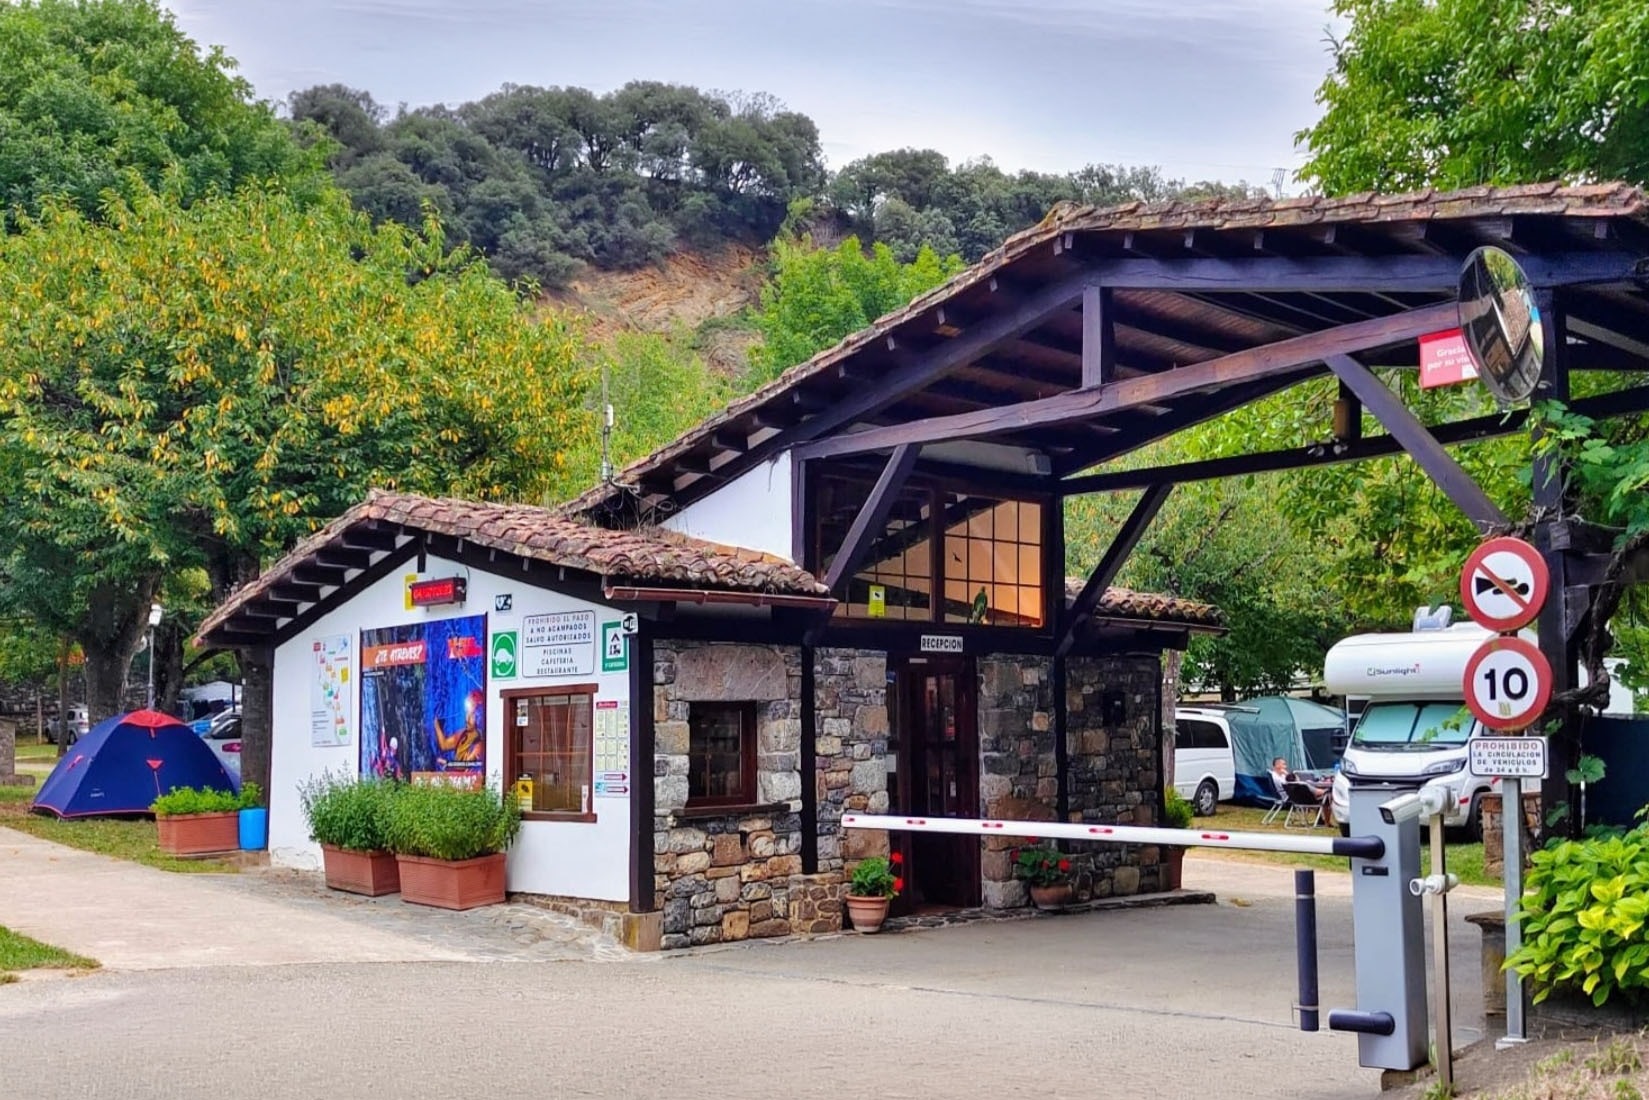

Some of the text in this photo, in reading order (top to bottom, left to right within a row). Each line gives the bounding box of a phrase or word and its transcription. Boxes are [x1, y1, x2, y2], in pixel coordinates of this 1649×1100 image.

[1436, 345, 1466, 358] Gracia
[528, 615, 561, 625] PROHIBIDO
[572, 613, 589, 621] PASO
[548, 622, 587, 633] ACAMPADOS
[526, 632, 591, 644] SALVO AUTORIZADOS
[542, 647, 572, 655] PISCINAS
[537, 665, 578, 675] RESTAURANTE
[1484, 667, 1528, 701] 10
[1475, 742, 1538, 750] PROHIBIDO
